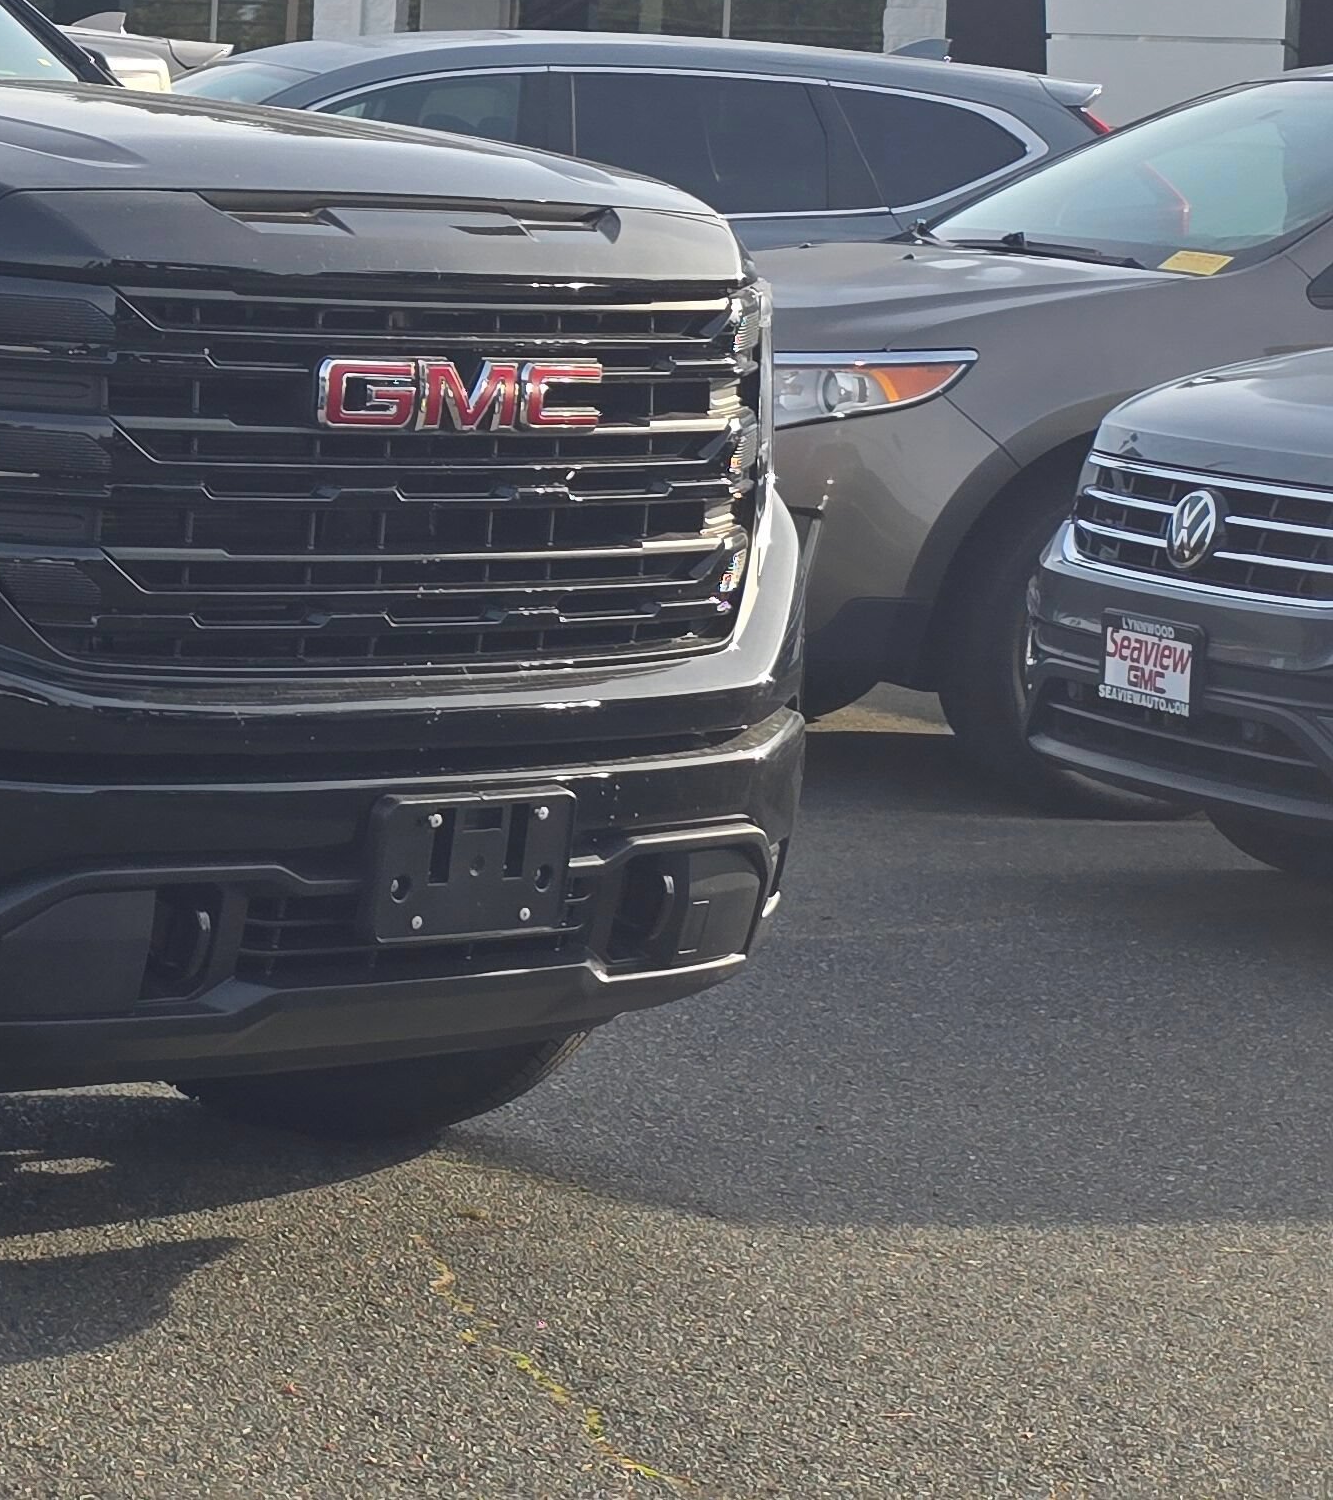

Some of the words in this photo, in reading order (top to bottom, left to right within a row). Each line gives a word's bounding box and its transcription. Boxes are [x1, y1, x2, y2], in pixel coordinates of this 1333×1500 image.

[317, 357, 603, 431] GMC
[1121, 616, 1175, 639] LYNNWOOD
[1105, 629, 1194, 675] Seaview
[1127, 664, 1167, 695] GMC
[1098, 684, 1190, 718] SEAVIEWAUTO.COM
